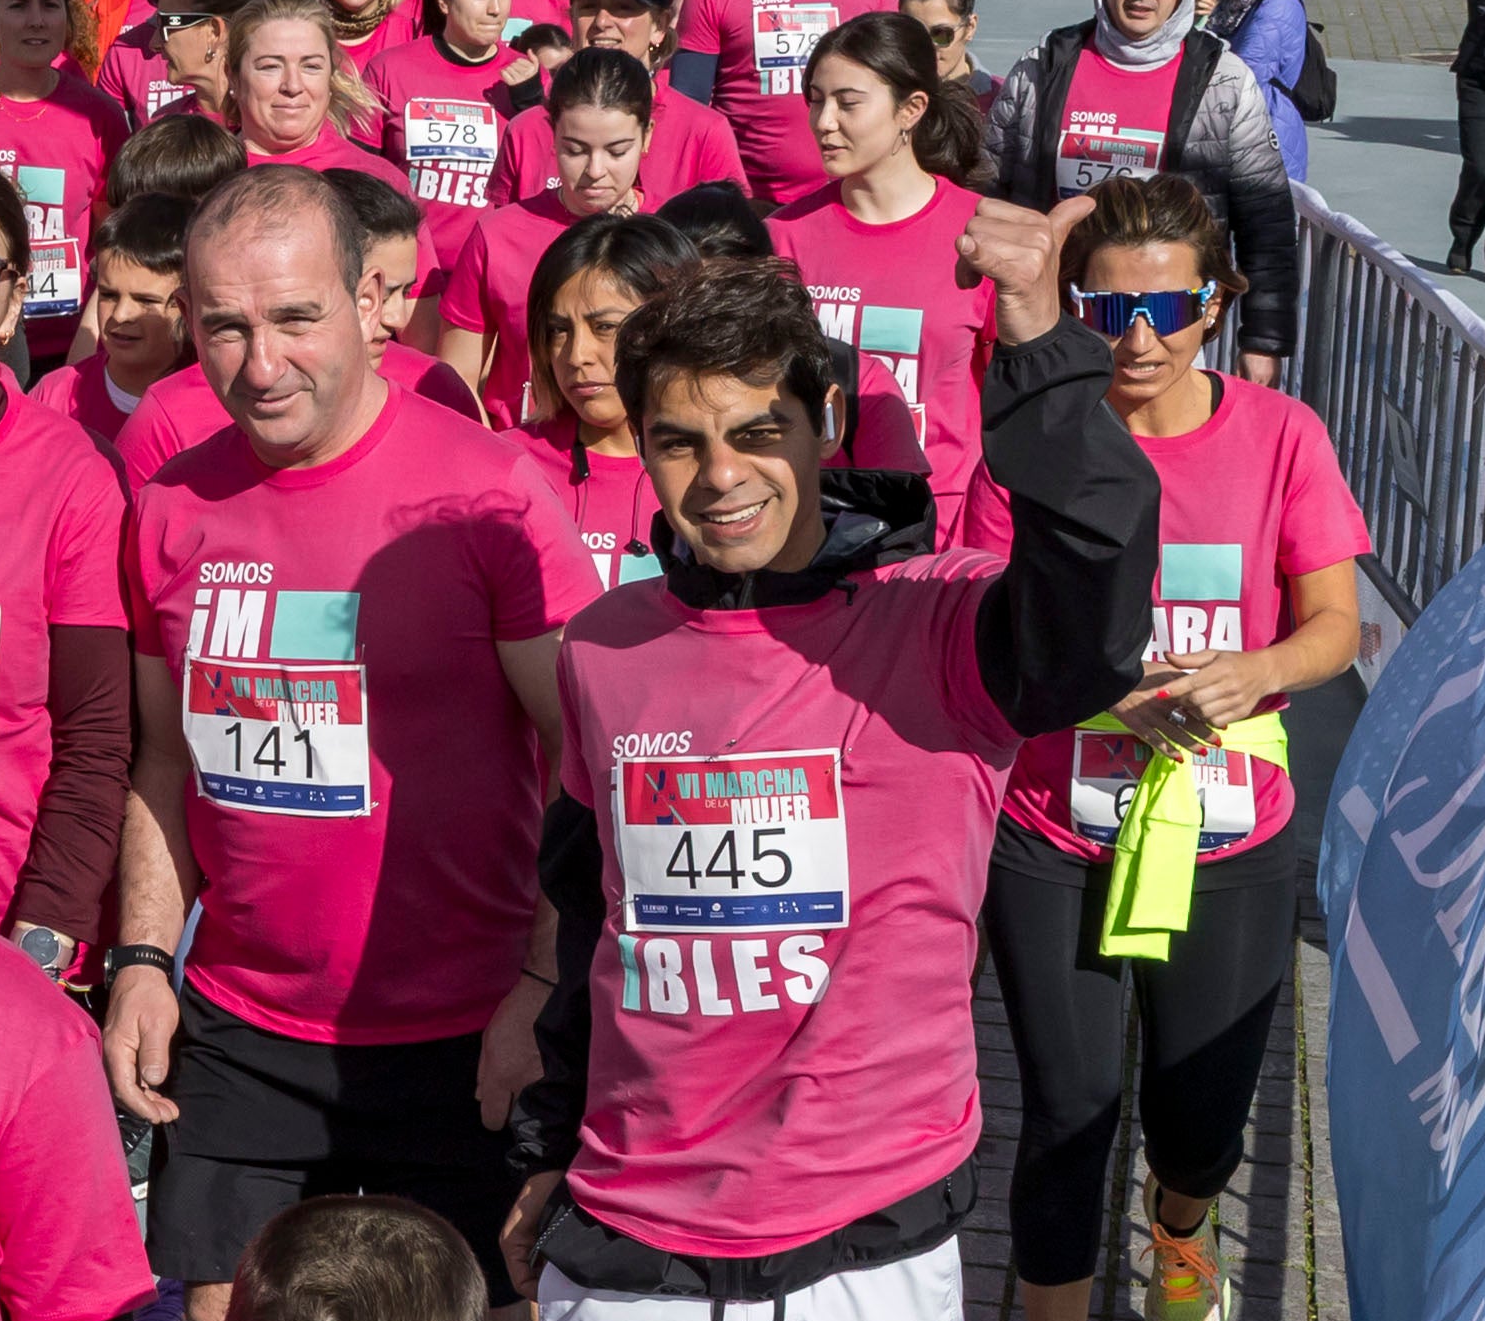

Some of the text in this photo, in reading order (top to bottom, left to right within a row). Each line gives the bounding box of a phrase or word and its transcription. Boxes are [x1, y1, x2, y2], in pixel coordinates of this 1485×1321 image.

[1070, 111, 1117, 125] SOMOS
[427, 122, 478, 144] 578
[1102, 140, 1147, 156] MARCHA
[1111, 154, 1145, 167] MUJER
[199, 562, 274, 584] SOMOS
[1142, 606, 1241, 665] ARA
[231, 676, 339, 702] VI MARCHA
[277, 702, 339, 725] MUJER
[225, 722, 314, 779] 141
[612, 731, 693, 759] SOMOS
[676, 767, 809, 799] VI MARCHA
[705, 798, 729, 808] DE LA
[730, 795, 811, 824] MUJER
[666, 827, 793, 890] 445
